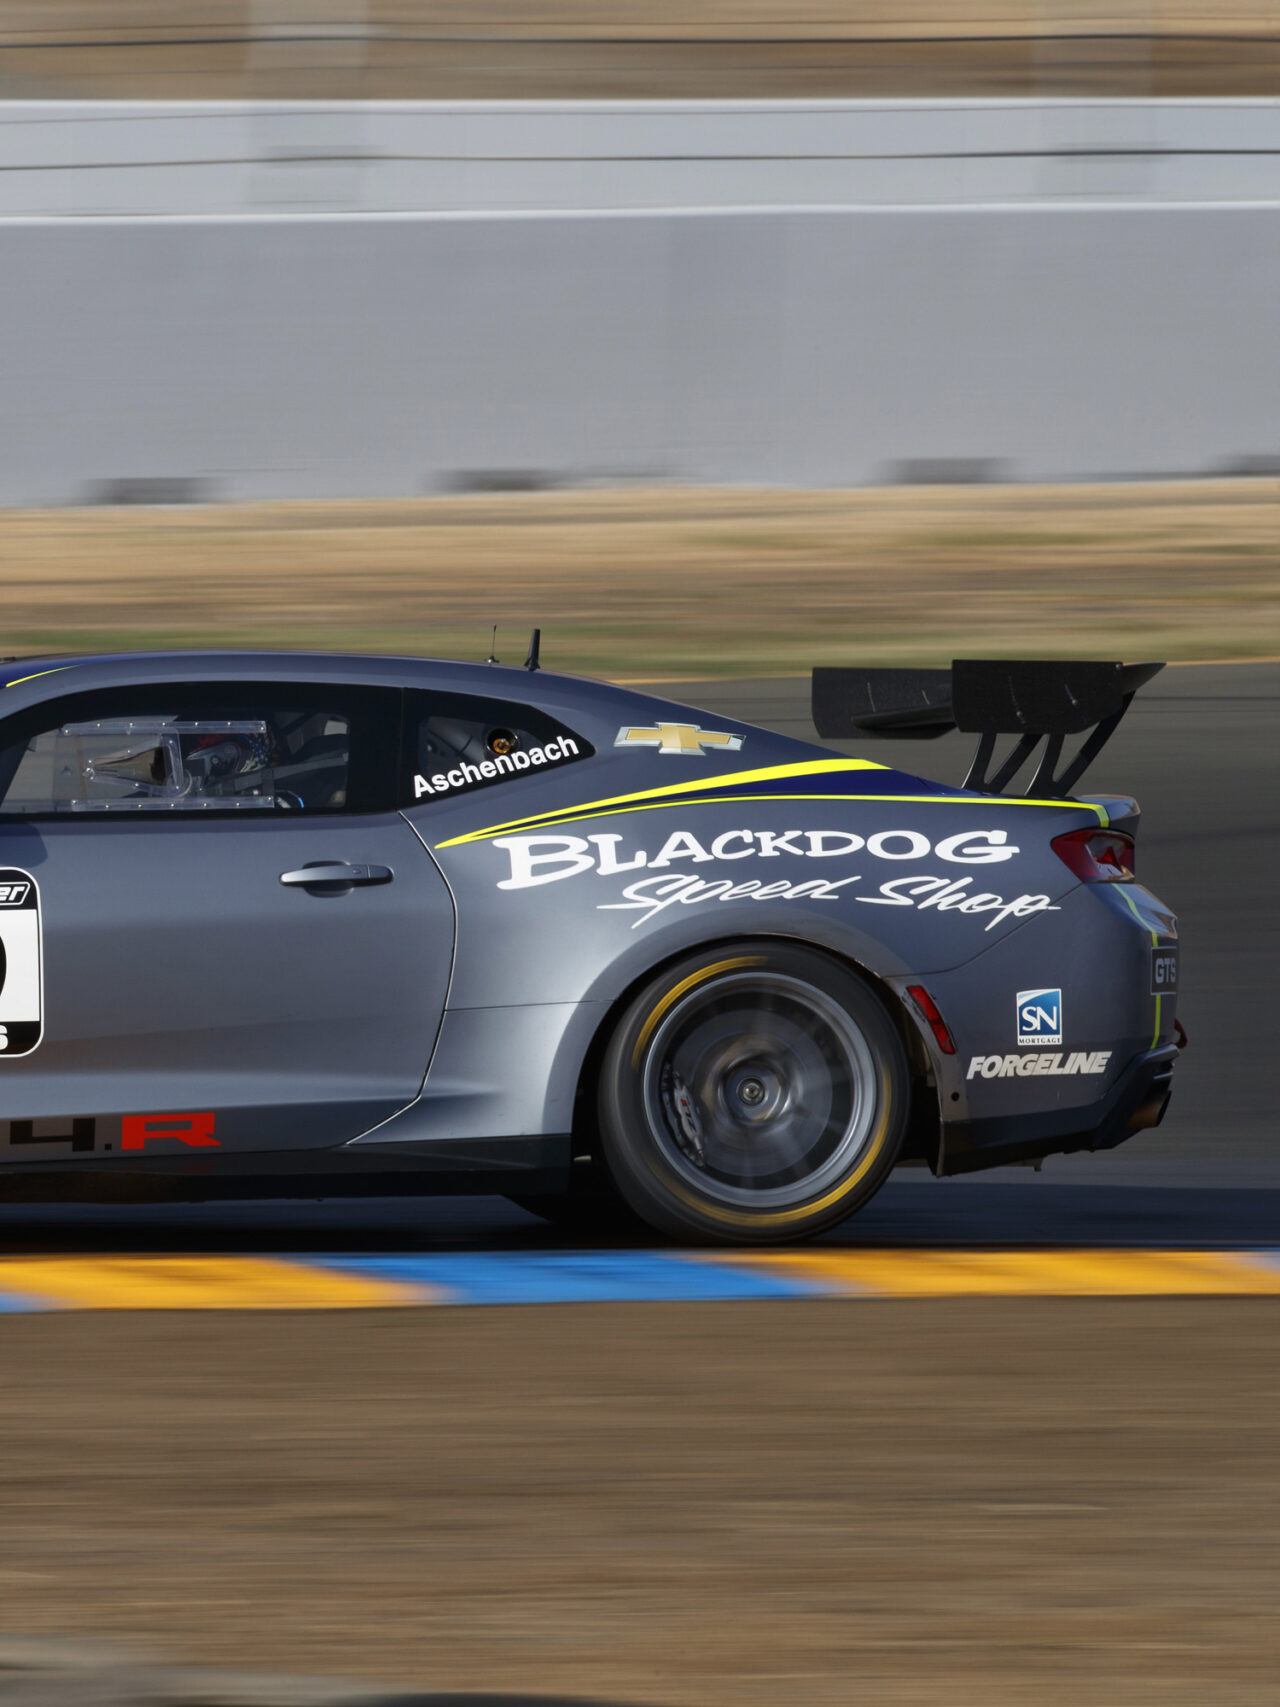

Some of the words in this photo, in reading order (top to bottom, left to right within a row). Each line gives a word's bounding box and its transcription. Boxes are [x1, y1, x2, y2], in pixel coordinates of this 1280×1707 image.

[414, 735, 580, 798] Aschenbach
[493, 830, 1020, 890] BLACKDOG
[596, 874, 861, 929] Speed
[856, 876, 1062, 931] Shop
[1155, 957, 1176, 984] GTS
[1021, 1006, 1058, 1032] SN
[1018, 1037, 1061, 1045] MORTGAGE
[966, 1052, 1113, 1081] FORGELINE
